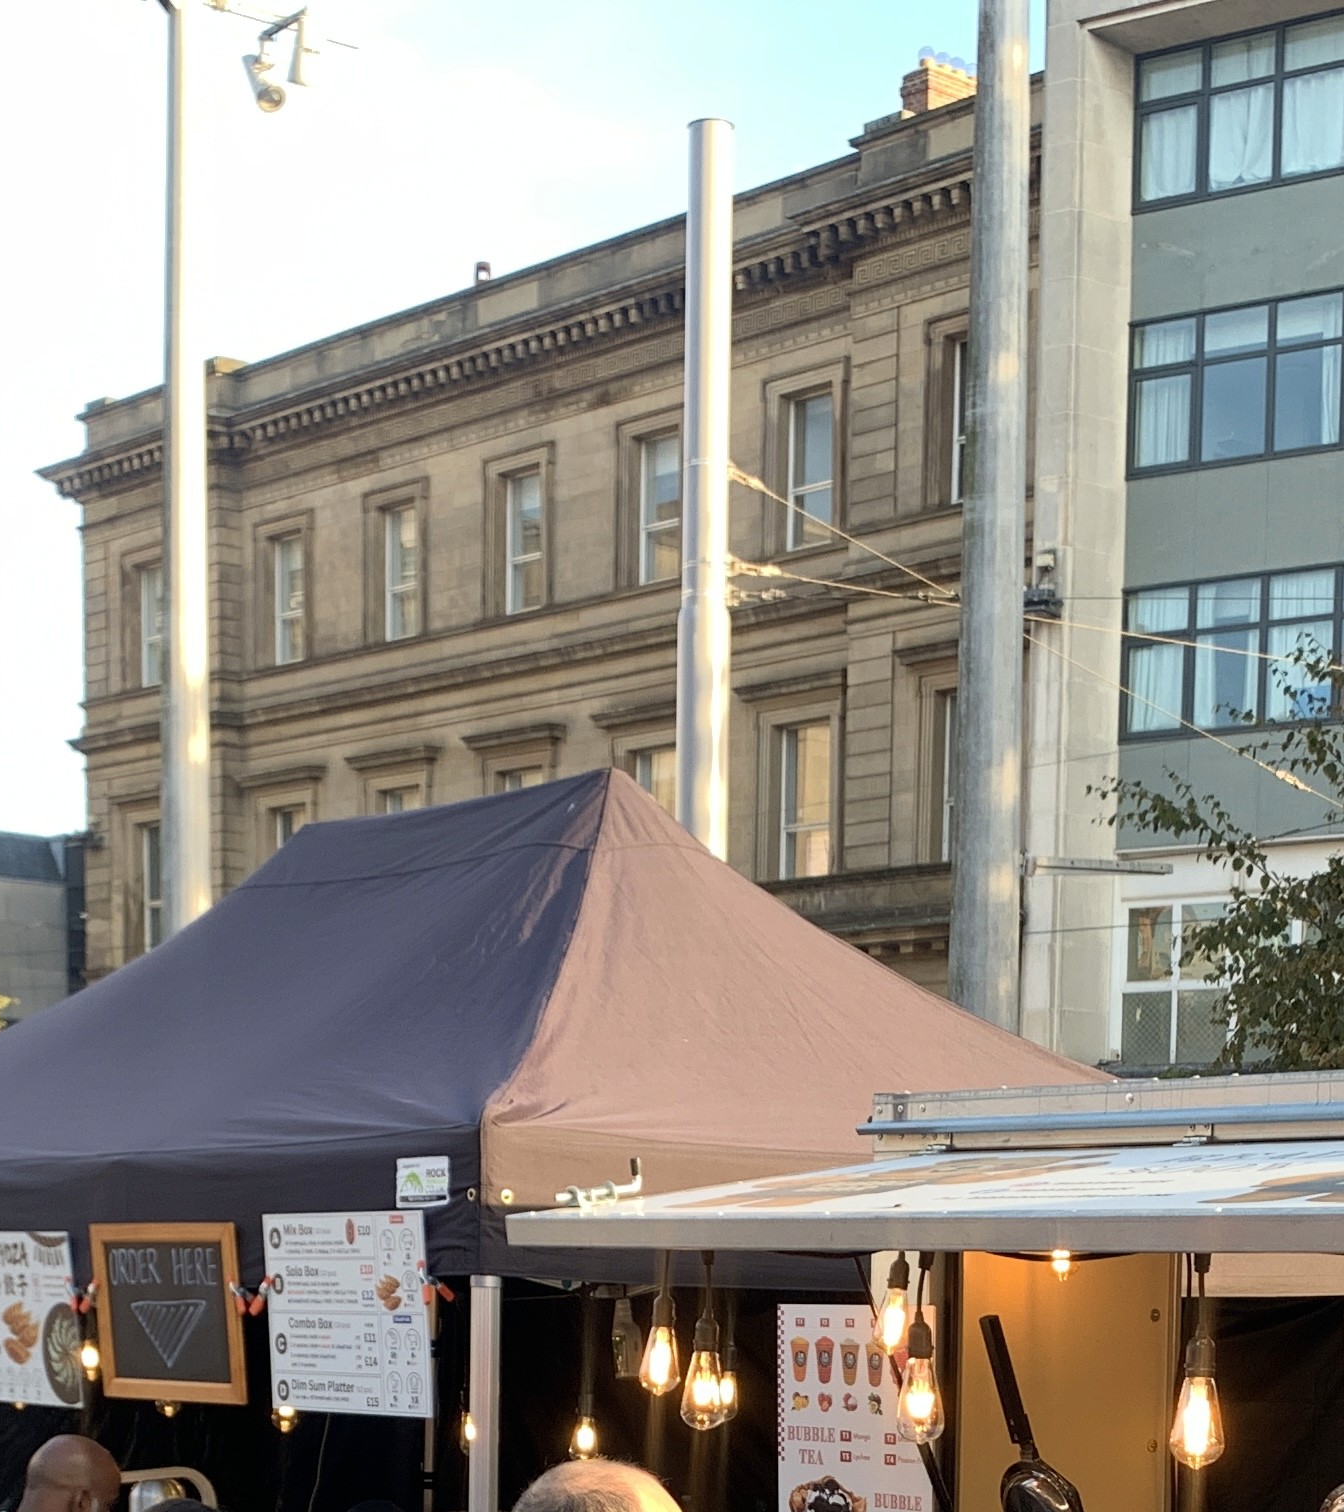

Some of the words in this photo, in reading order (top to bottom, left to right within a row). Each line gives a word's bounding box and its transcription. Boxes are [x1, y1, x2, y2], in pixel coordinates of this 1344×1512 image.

[298, 1224, 313, 1236] Box
[108, 1248, 162, 1286] ORDER
[172, 1246, 218, 1287] HERE
[304, 1265, 319, 1276] Box
[318, 1317, 333, 1329] Box
[292, 1379, 307, 1390] Dim
[309, 1380, 325, 1391] Sum
[328, 1380, 355, 1393] Platter
[787, 1425, 835, 1443] BUBBLE
[799, 1448, 824, 1465] TEA
[874, 1492, 922, 1512] BUBBLE
